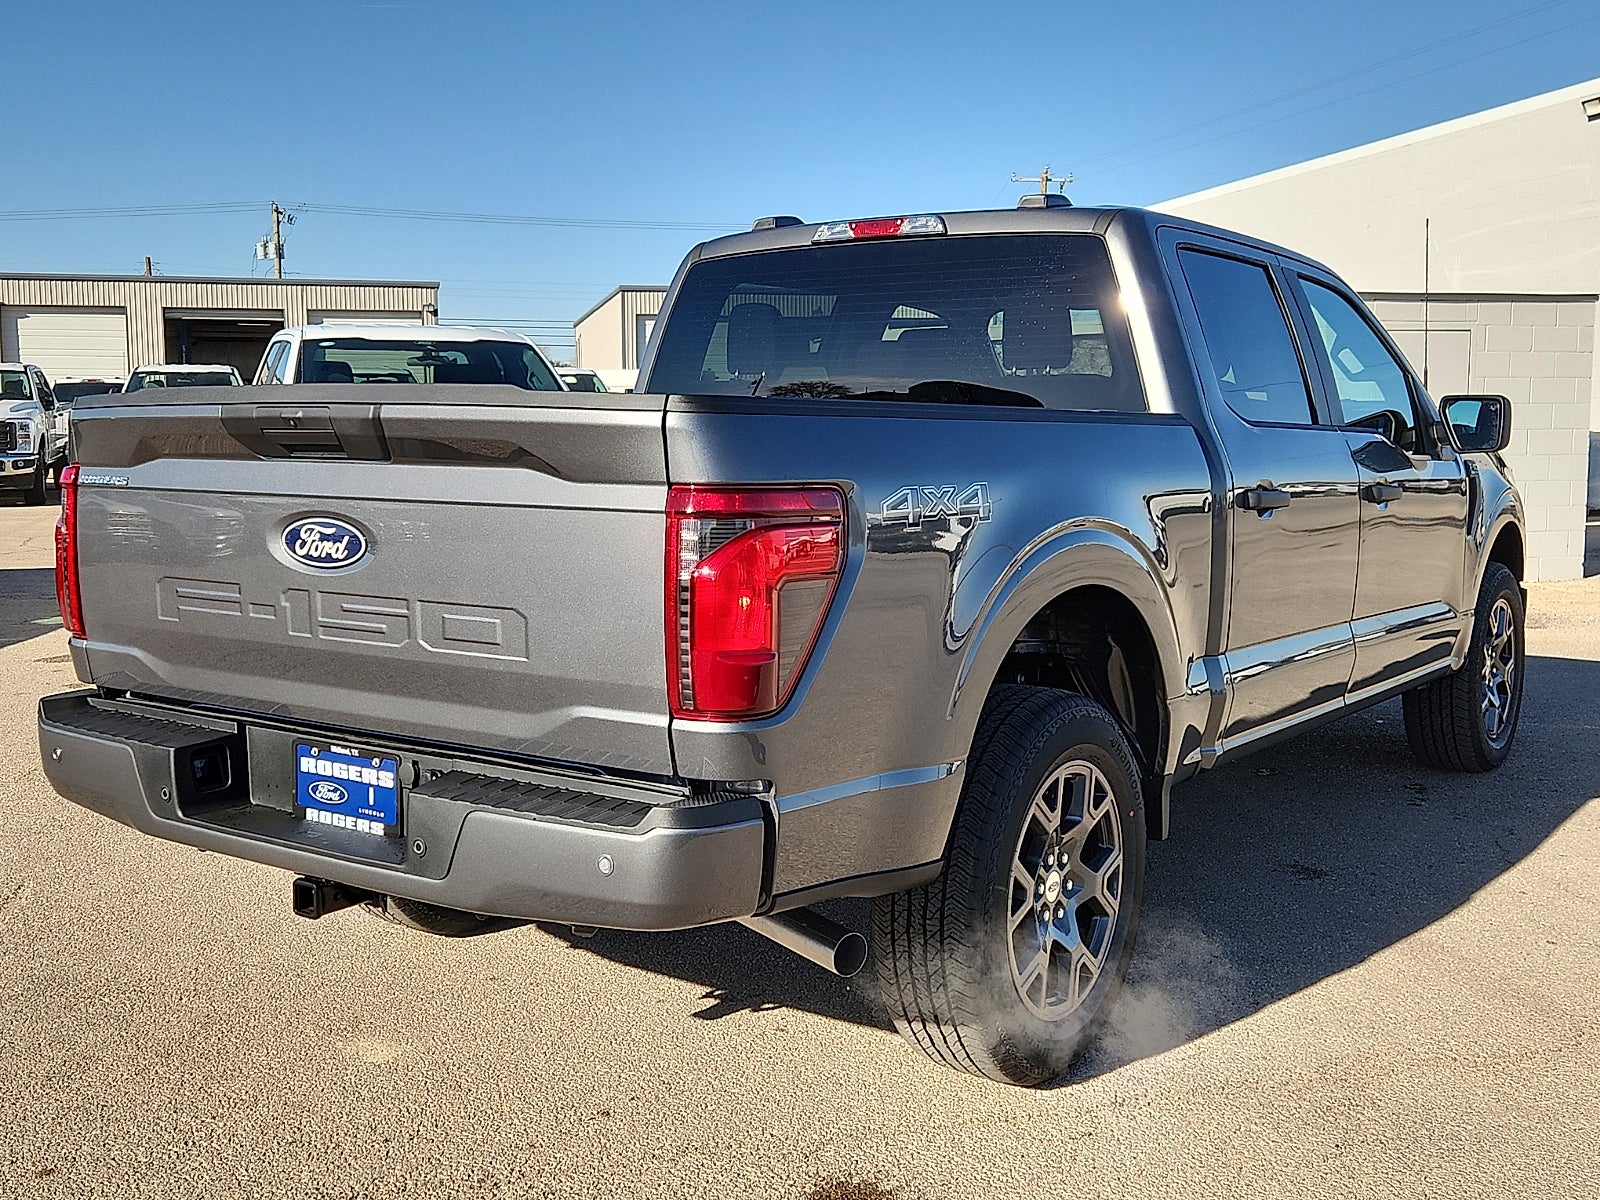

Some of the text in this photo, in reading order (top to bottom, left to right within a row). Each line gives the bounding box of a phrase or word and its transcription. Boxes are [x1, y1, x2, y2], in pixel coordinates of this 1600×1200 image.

[294, 523, 349, 560] Ford
[156, 576, 529, 662] F-150
[300, 756, 394, 788] ROGERS
[316, 784, 341, 801] Ford
[306, 808, 385, 837] ROGERS
[358, 807, 385, 818] LINCOLN
